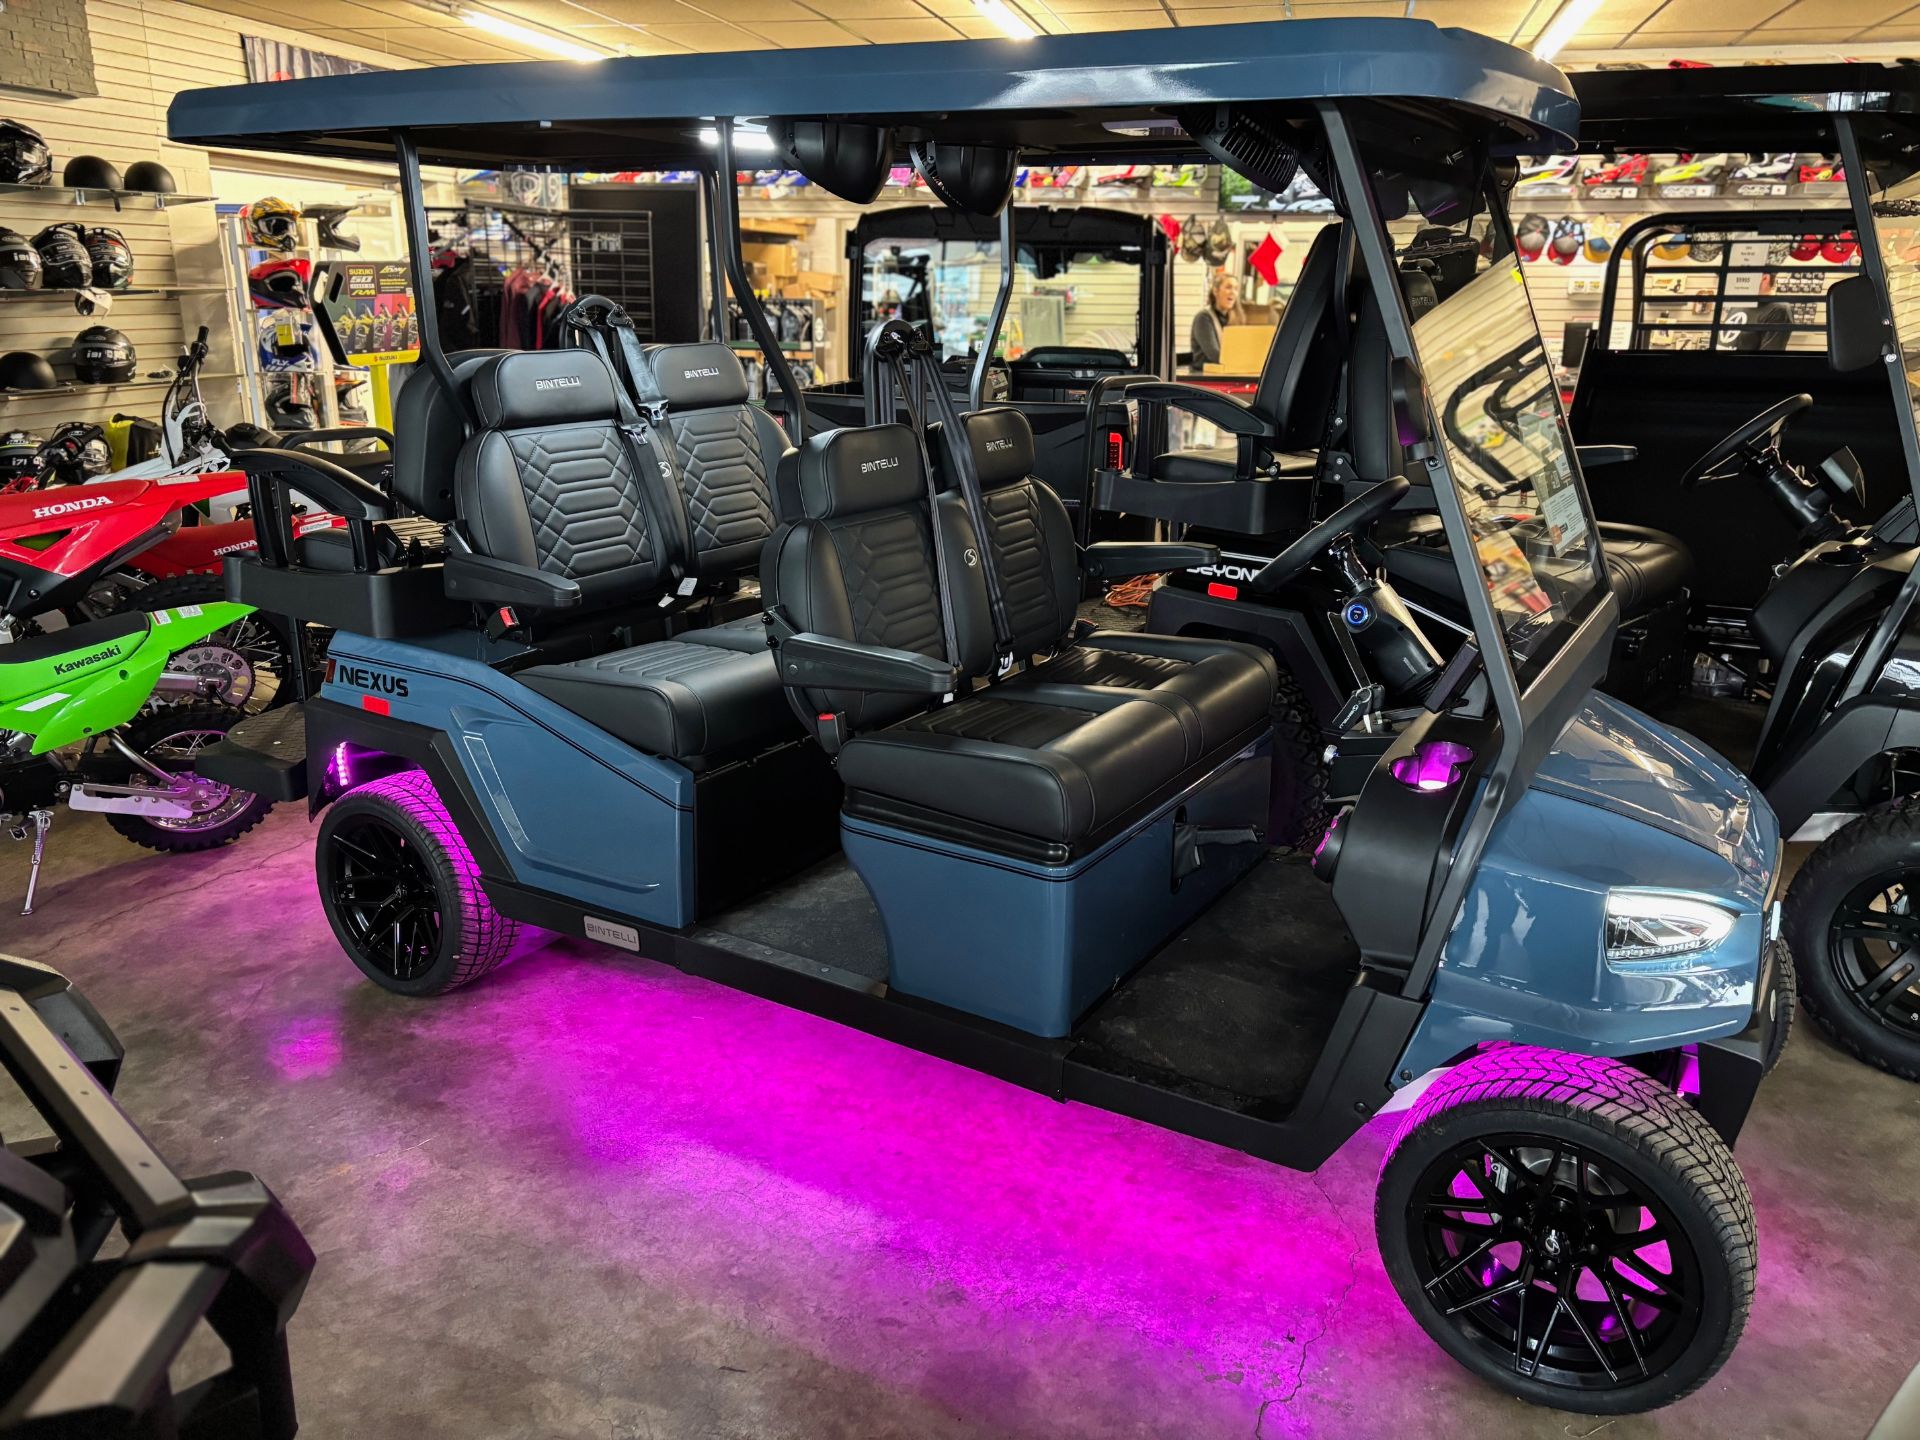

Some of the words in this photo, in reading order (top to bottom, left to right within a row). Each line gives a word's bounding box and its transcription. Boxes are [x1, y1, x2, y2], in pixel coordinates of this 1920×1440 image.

[683, 367, 720, 379] BINTELLI
[535, 376, 581, 390] BINTELLI
[985, 439, 1014, 452] BINTELLI
[860, 457, 899, 473] BINTELLI
[32, 496, 114, 518] HONDA
[212, 539, 258, 556] HONDA
[53, 644, 122, 675] Kawasaki
[339, 664, 409, 698] NEXUS
[586, 922, 638, 944] BINTELLI
